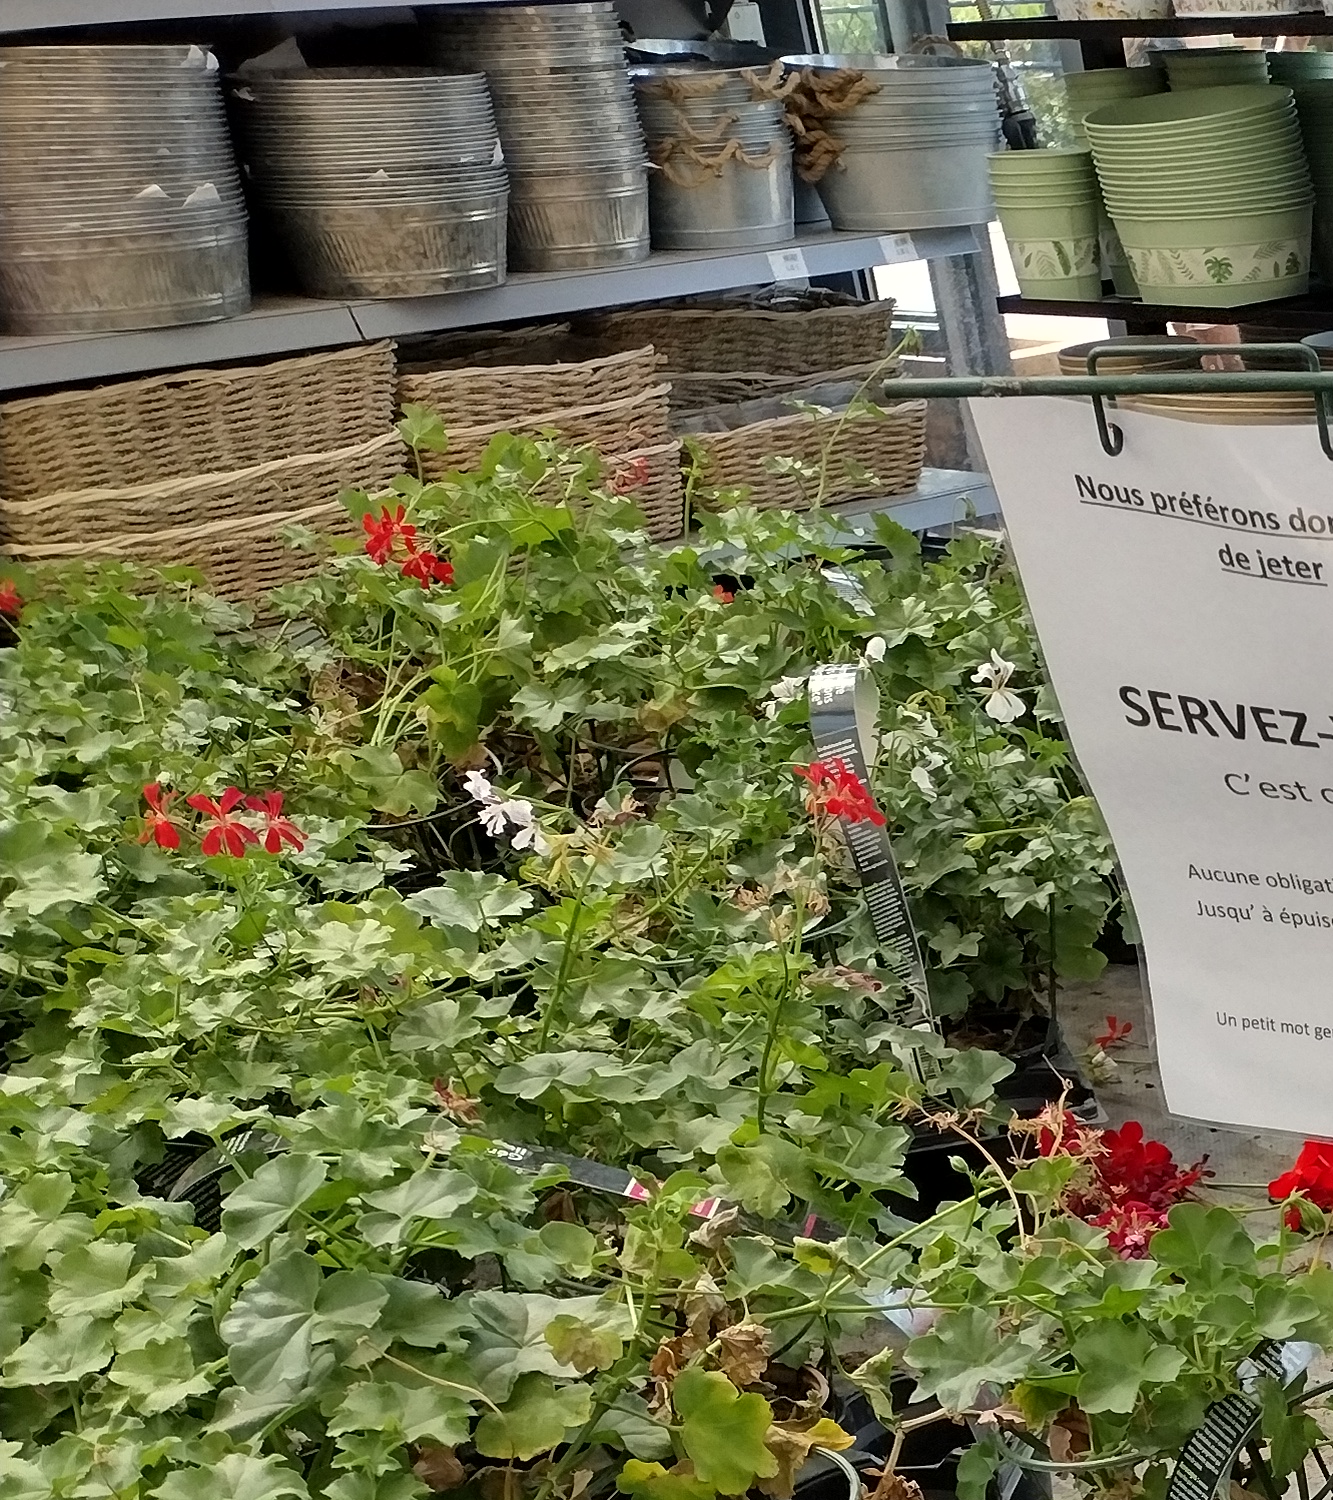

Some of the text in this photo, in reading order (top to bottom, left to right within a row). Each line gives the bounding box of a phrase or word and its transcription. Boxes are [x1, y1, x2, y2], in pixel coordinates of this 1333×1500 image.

[1075, 474, 1144, 507] Nous
[1150, 486, 1280, 533] préférons
[1219, 544, 1323, 582] de jeter
[1223, 772, 1313, 803] C'est
[1188, 863, 1261, 886] Aucune
[1197, 900, 1255, 924] Jusqu'
[1262, 904, 1274, 923] à
[1216, 1011, 1238, 1027] Un
[1241, 1017, 1277, 1032] petit
[1280, 1022, 1311, 1036] mot
